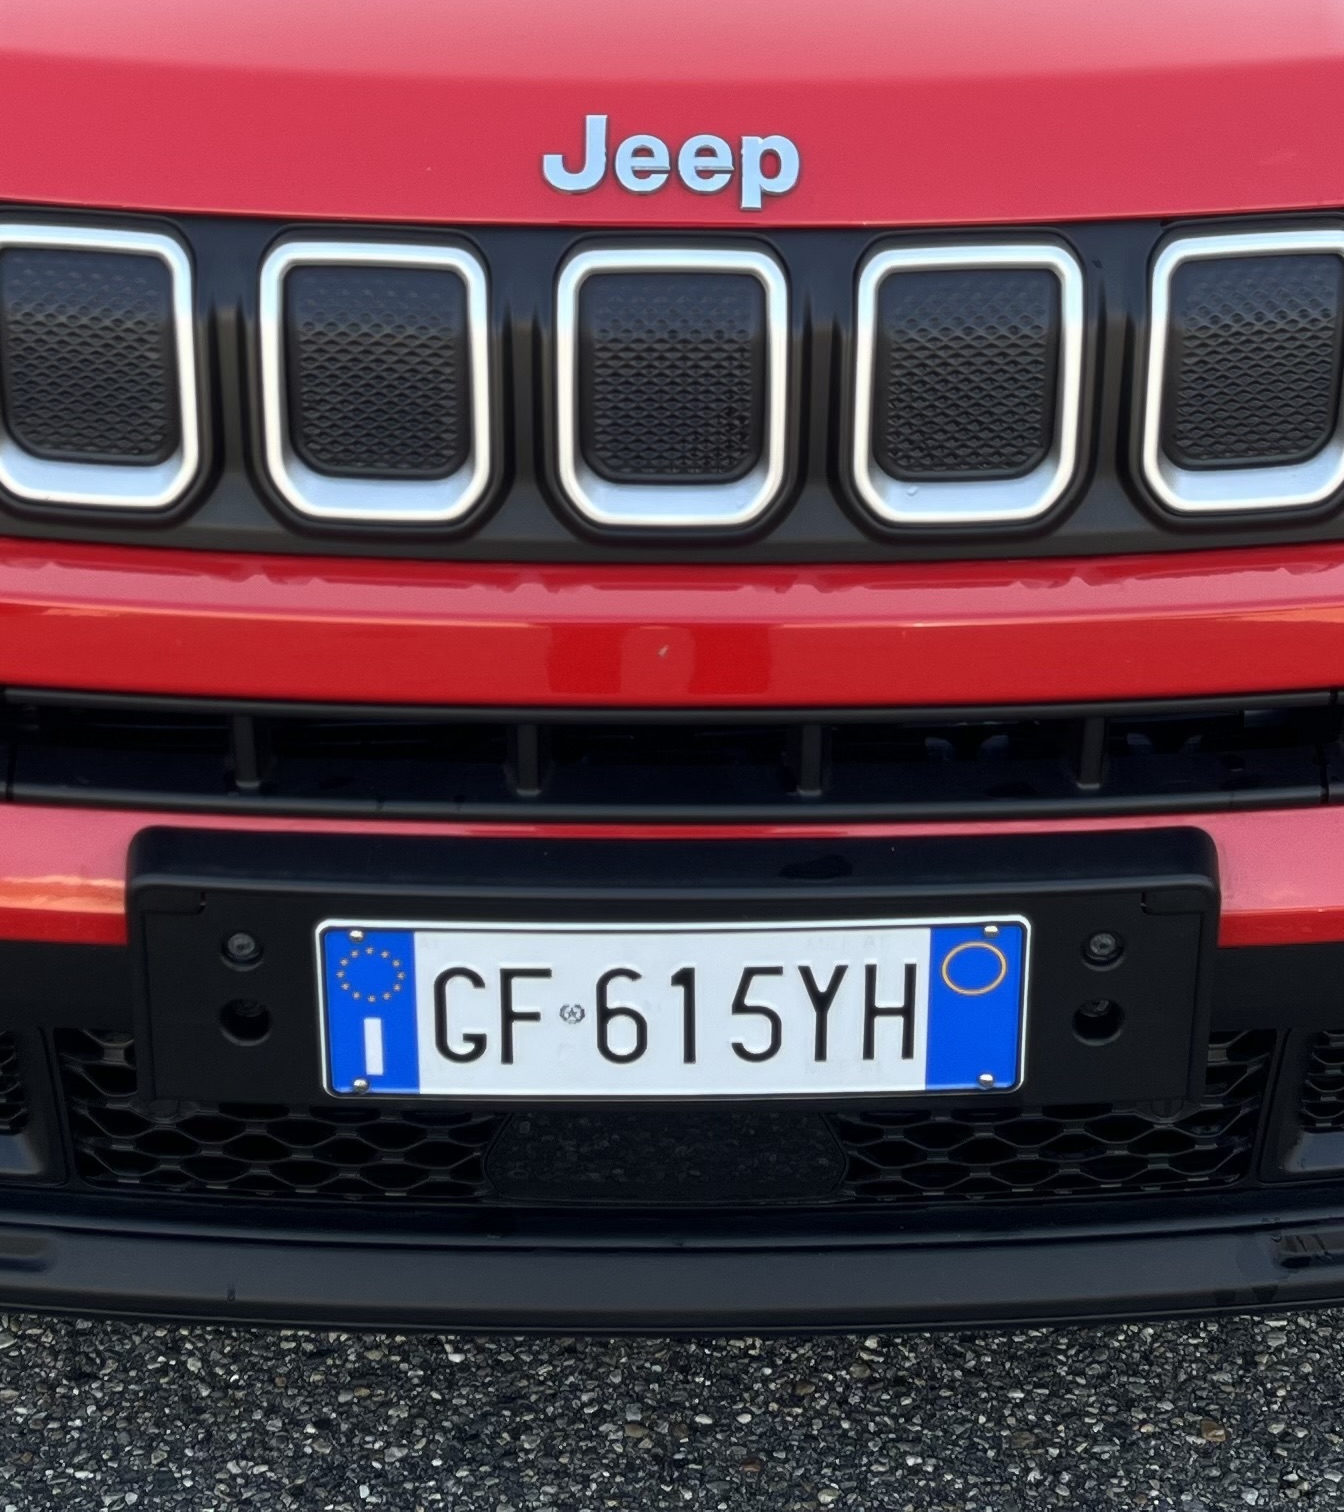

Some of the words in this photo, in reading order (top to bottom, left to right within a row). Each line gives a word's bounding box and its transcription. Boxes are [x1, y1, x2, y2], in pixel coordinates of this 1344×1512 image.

[542, 114, 801, 212] Jeep
[363, 1017, 384, 1076] I
[433, 965, 553, 1065] GF
[596, 963, 918, 1064] 615YH
